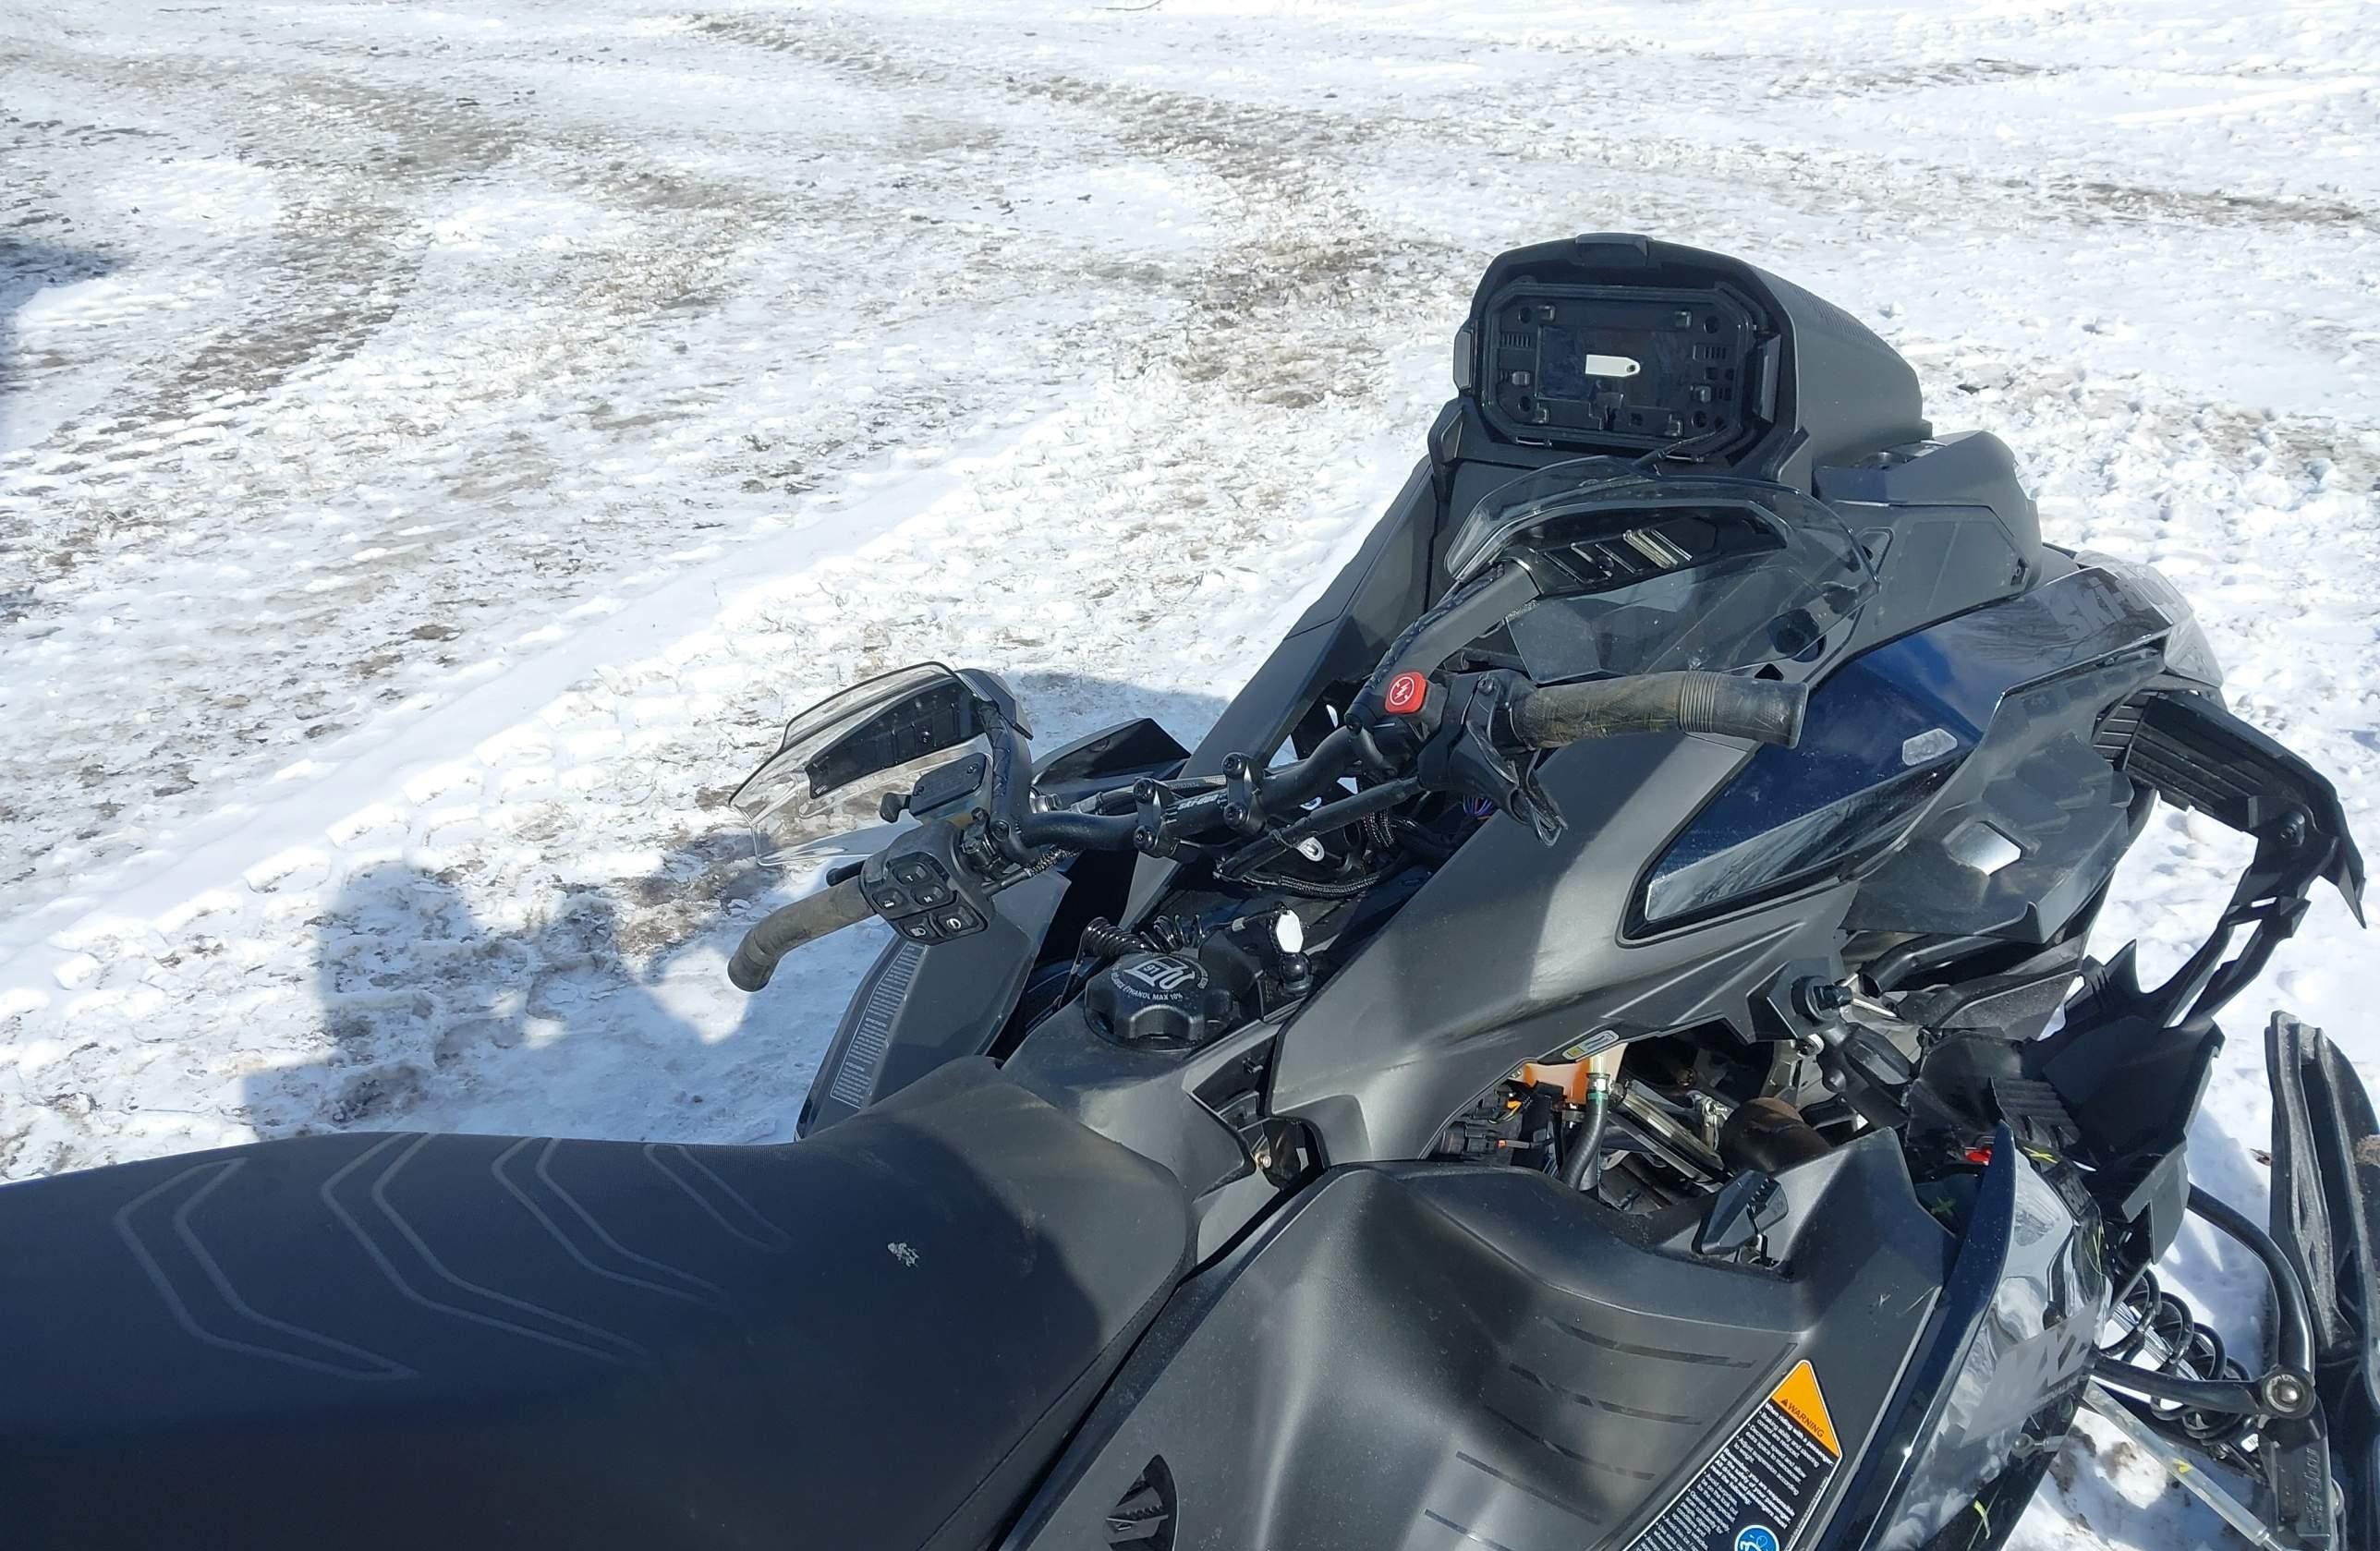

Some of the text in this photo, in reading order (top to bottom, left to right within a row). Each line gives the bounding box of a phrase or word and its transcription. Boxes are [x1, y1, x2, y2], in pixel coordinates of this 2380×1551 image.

[1143, 963, 1160, 974] 91
[1764, 1402, 1779, 1417] When
[1777, 1414, 1793, 1430] riding
[1791, 1427, 1804, 1439] with
[1787, 1402, 1825, 1437] WARNING
[1737, 1447, 1755, 1464] weight.
[1744, 1430, 1758, 1443] extra
[1755, 1441, 1771, 1456] space
[1769, 1452, 1777, 1460] to
[1749, 1424, 1807, 1478] Decrease speed and allow
[1755, 1418, 1800, 1459] control are reduced.
[1759, 1412, 1819, 1468] Braking ability and steering
[1705, 1472, 1719, 1486] Avoid
[1709, 1464, 1722, 1476] read
[1720, 1473, 1730, 1484] the
[1718, 1453, 1728, 1462] for
[1726, 1460, 1735, 1470] the
[1733, 1468, 1750, 1484] safety
[1752, 1486, 1766, 1499] your
[1723, 1448, 1796, 1517] Remember: you are responsible
[1737, 1436, 1800, 1496] Adjust suspension according
[1689, 1490, 1707, 1509] Operate
[1700, 1478, 1708, 1486] be
[1712, 1489, 1722, 1498] the
[1719, 1496, 1730, 1508] look
[1729, 1506, 1739, 1515] out
[1702, 1489, 1712, 1499] the
[1714, 1459, 1788, 1529] All drivers and passengers must
[1664, 1517, 1677, 1530] Avoid
[1684, 1496, 1724, 1534] scan constantly for
[1695, 1526, 1706, 1537] and
